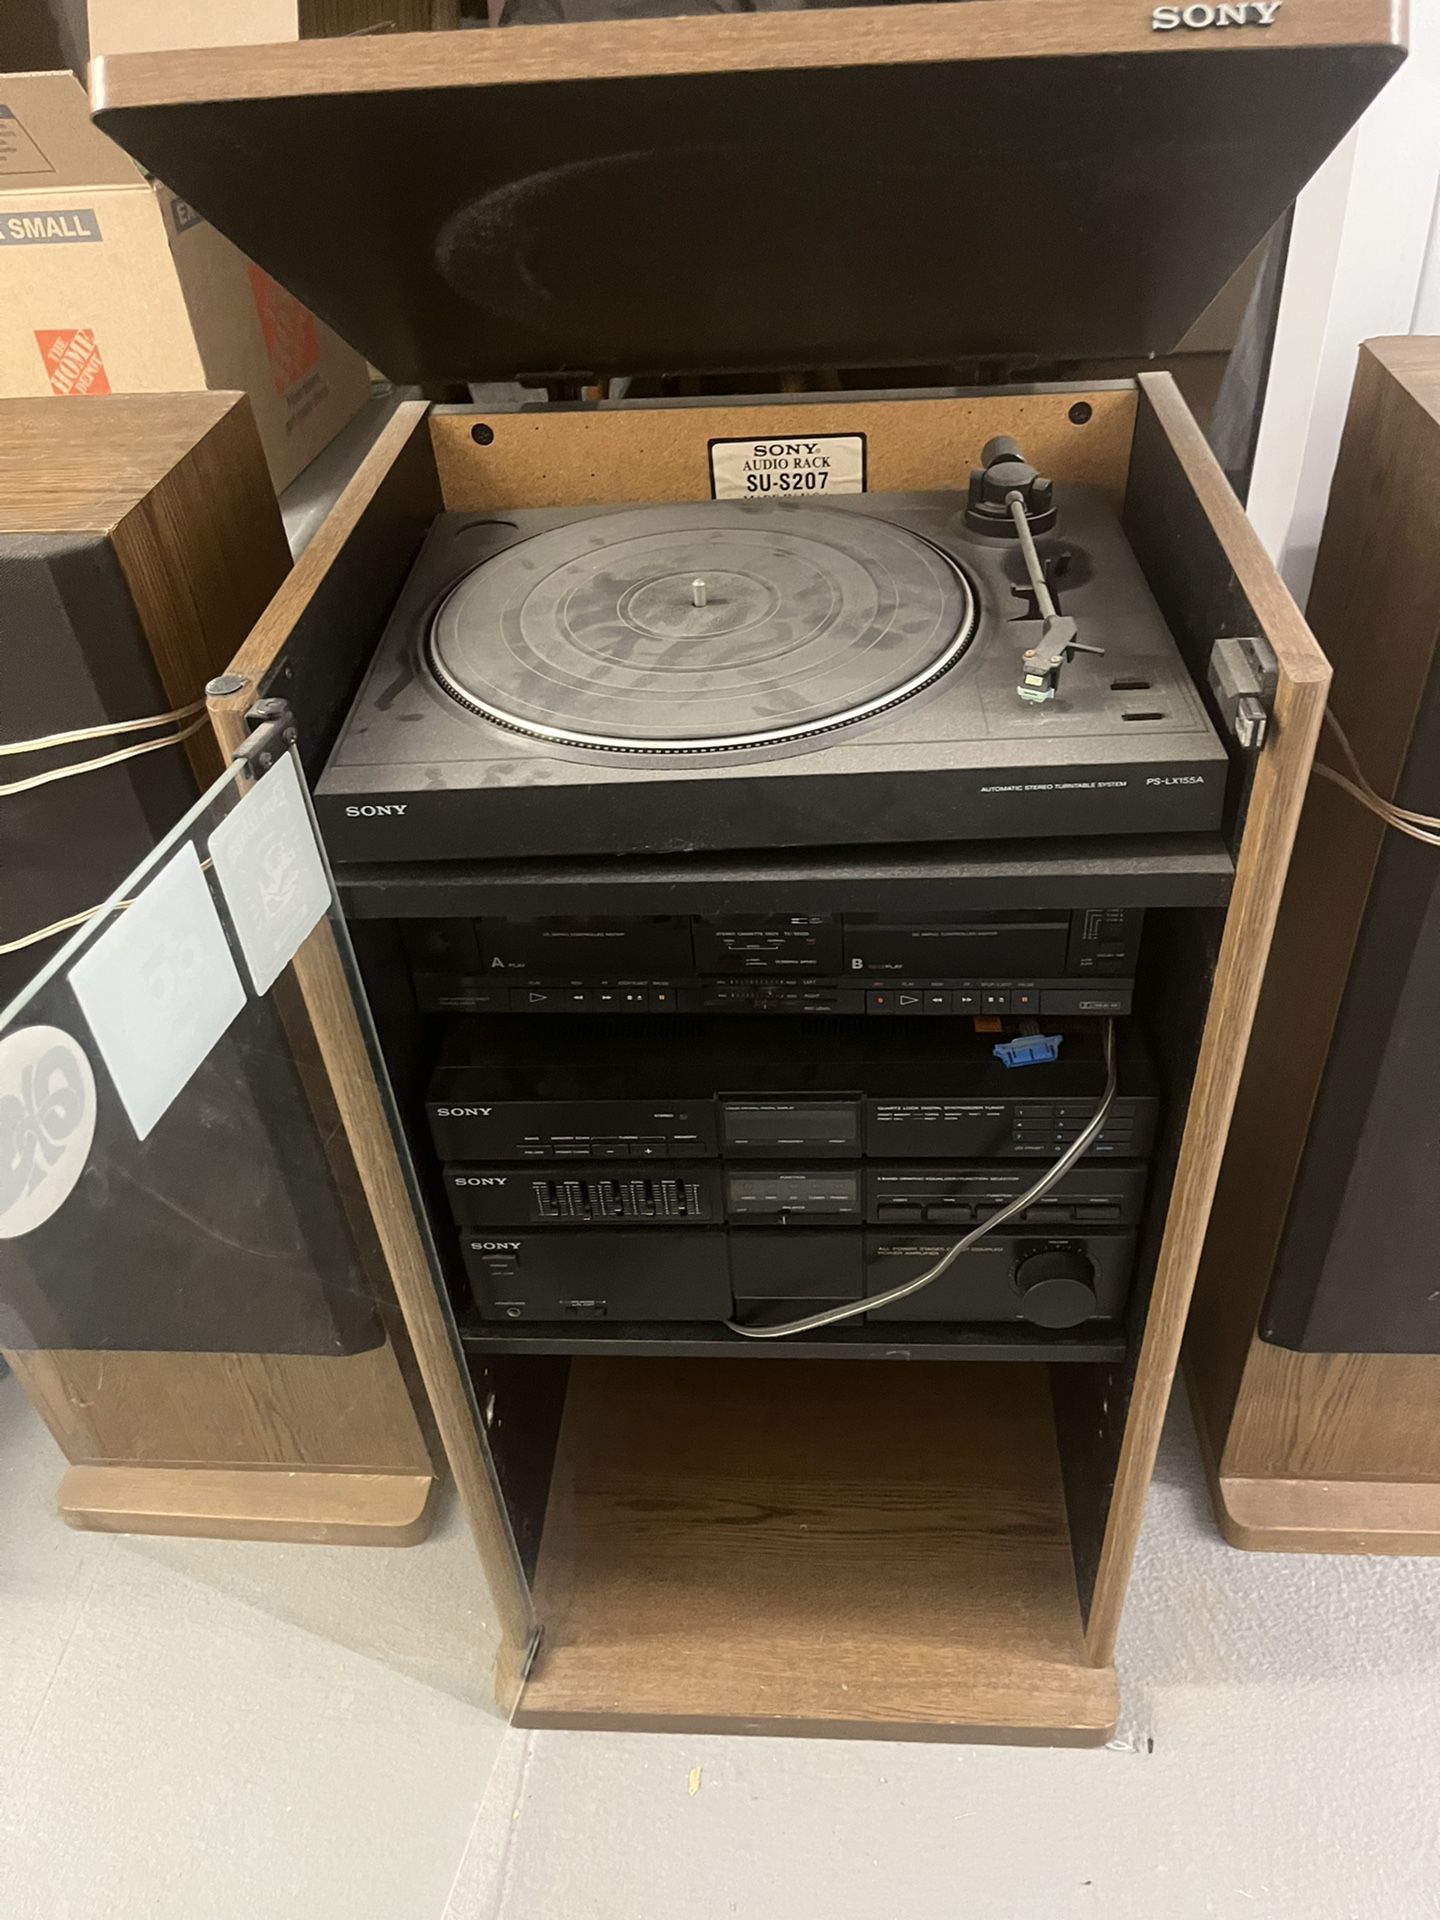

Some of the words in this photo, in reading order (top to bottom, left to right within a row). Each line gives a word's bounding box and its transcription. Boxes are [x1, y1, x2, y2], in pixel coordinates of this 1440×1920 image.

[1152, 1, 1283, 30] SONY
[7, 214, 92, 240] SMALL
[48, 336, 68, 362] THE
[50, 328, 97, 396] HOME
[753, 443, 818, 457] SONY
[743, 458, 789, 472] AUDIO
[793, 456, 832, 469] RACK
[746, 471, 829, 492] SU-S207
[980, 784, 1023, 793] AUTOMATIC
[1024, 783, 1054, 791] STEREO
[1055, 782, 1096, 790] TURNTABLE
[1097, 780, 1127, 788] SYSTEM
[1145, 775, 1205, 786] PS-LX155A
[345, 804, 408, 817] SONY
[491, 956, 505, 968] A
[851, 958, 863, 969] B
[437, 1107, 493, 1117] SONY
[455, 1177, 508, 1186] SONY
[470, 1242, 522, 1251] SONY
